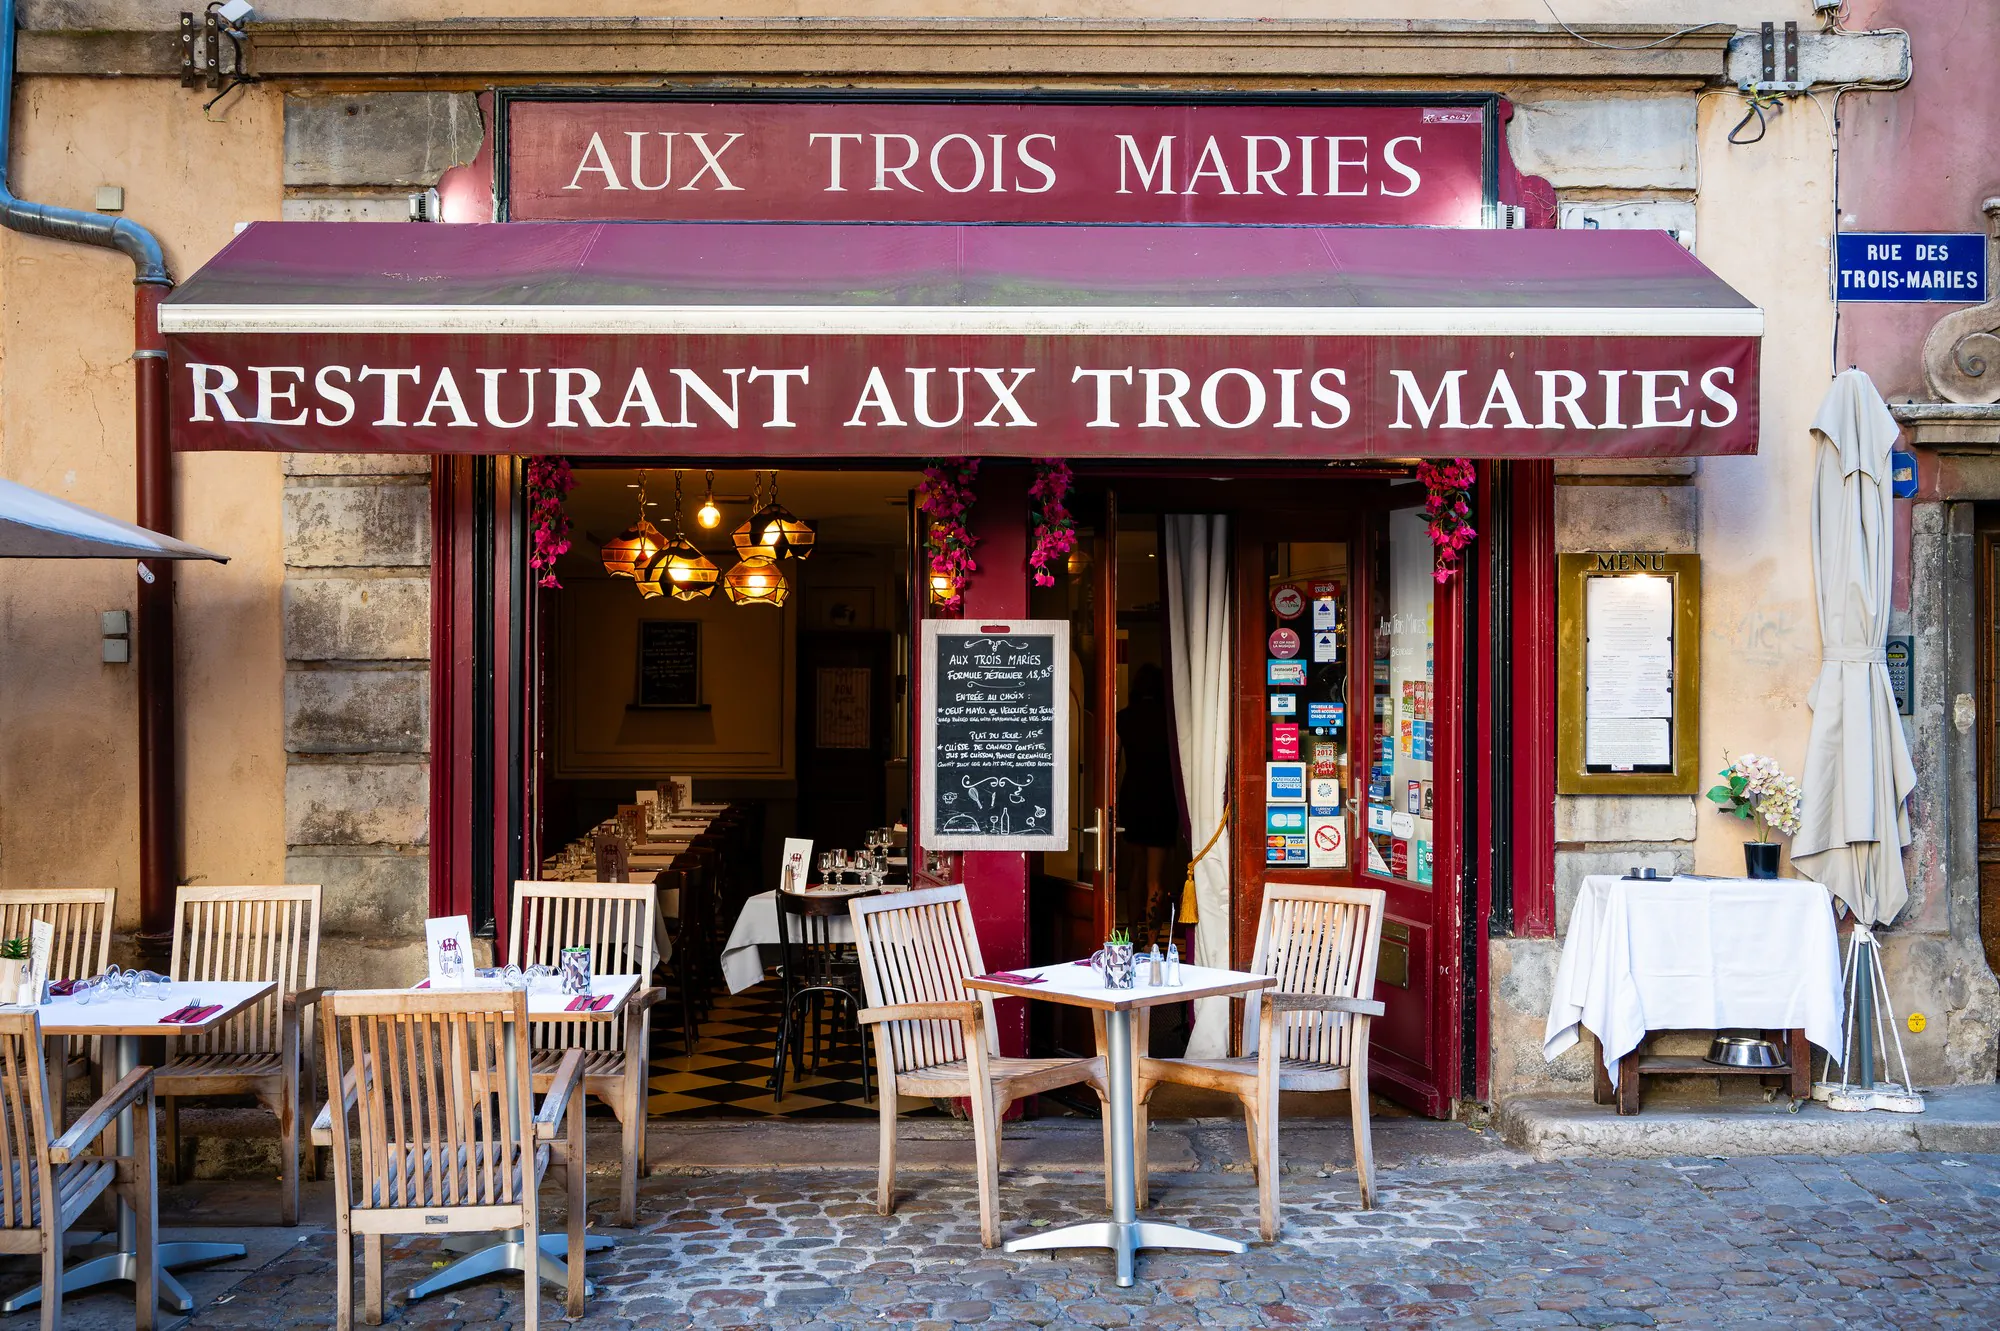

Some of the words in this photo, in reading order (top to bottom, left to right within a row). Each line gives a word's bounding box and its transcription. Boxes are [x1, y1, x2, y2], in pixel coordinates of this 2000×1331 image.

[563, 132, 745, 191] AUX
[810, 133, 1056, 194] TROIS
[1115, 135, 1422, 197] MARIES
[1867, 244, 1902, 261] RUE
[1915, 244, 1949, 261] DES
[1841, 270, 1978, 289] TROIS-MARIES
[186, 362, 809, 428] RESTAURANT
[844, 366, 1037, 428] AUX
[1072, 366, 1350, 429] TROIS
[1389, 367, 1738, 430] MARIES
[1597, 554, 1665, 571] MENU
[949, 654, 968, 666] AUX
[974, 652, 1002, 665] TROIS
[1008, 652, 1041, 666] MARIES
[947, 670, 982, 680] FORMULE
[984, 670, 1023, 680] DÉJEUNER
[956, 691, 984, 701] ENTRÉE
[969, 731, 987, 740] PLAT
[945, 742, 970, 751] CUISSE
[1271, 814, 1302, 827] CB
